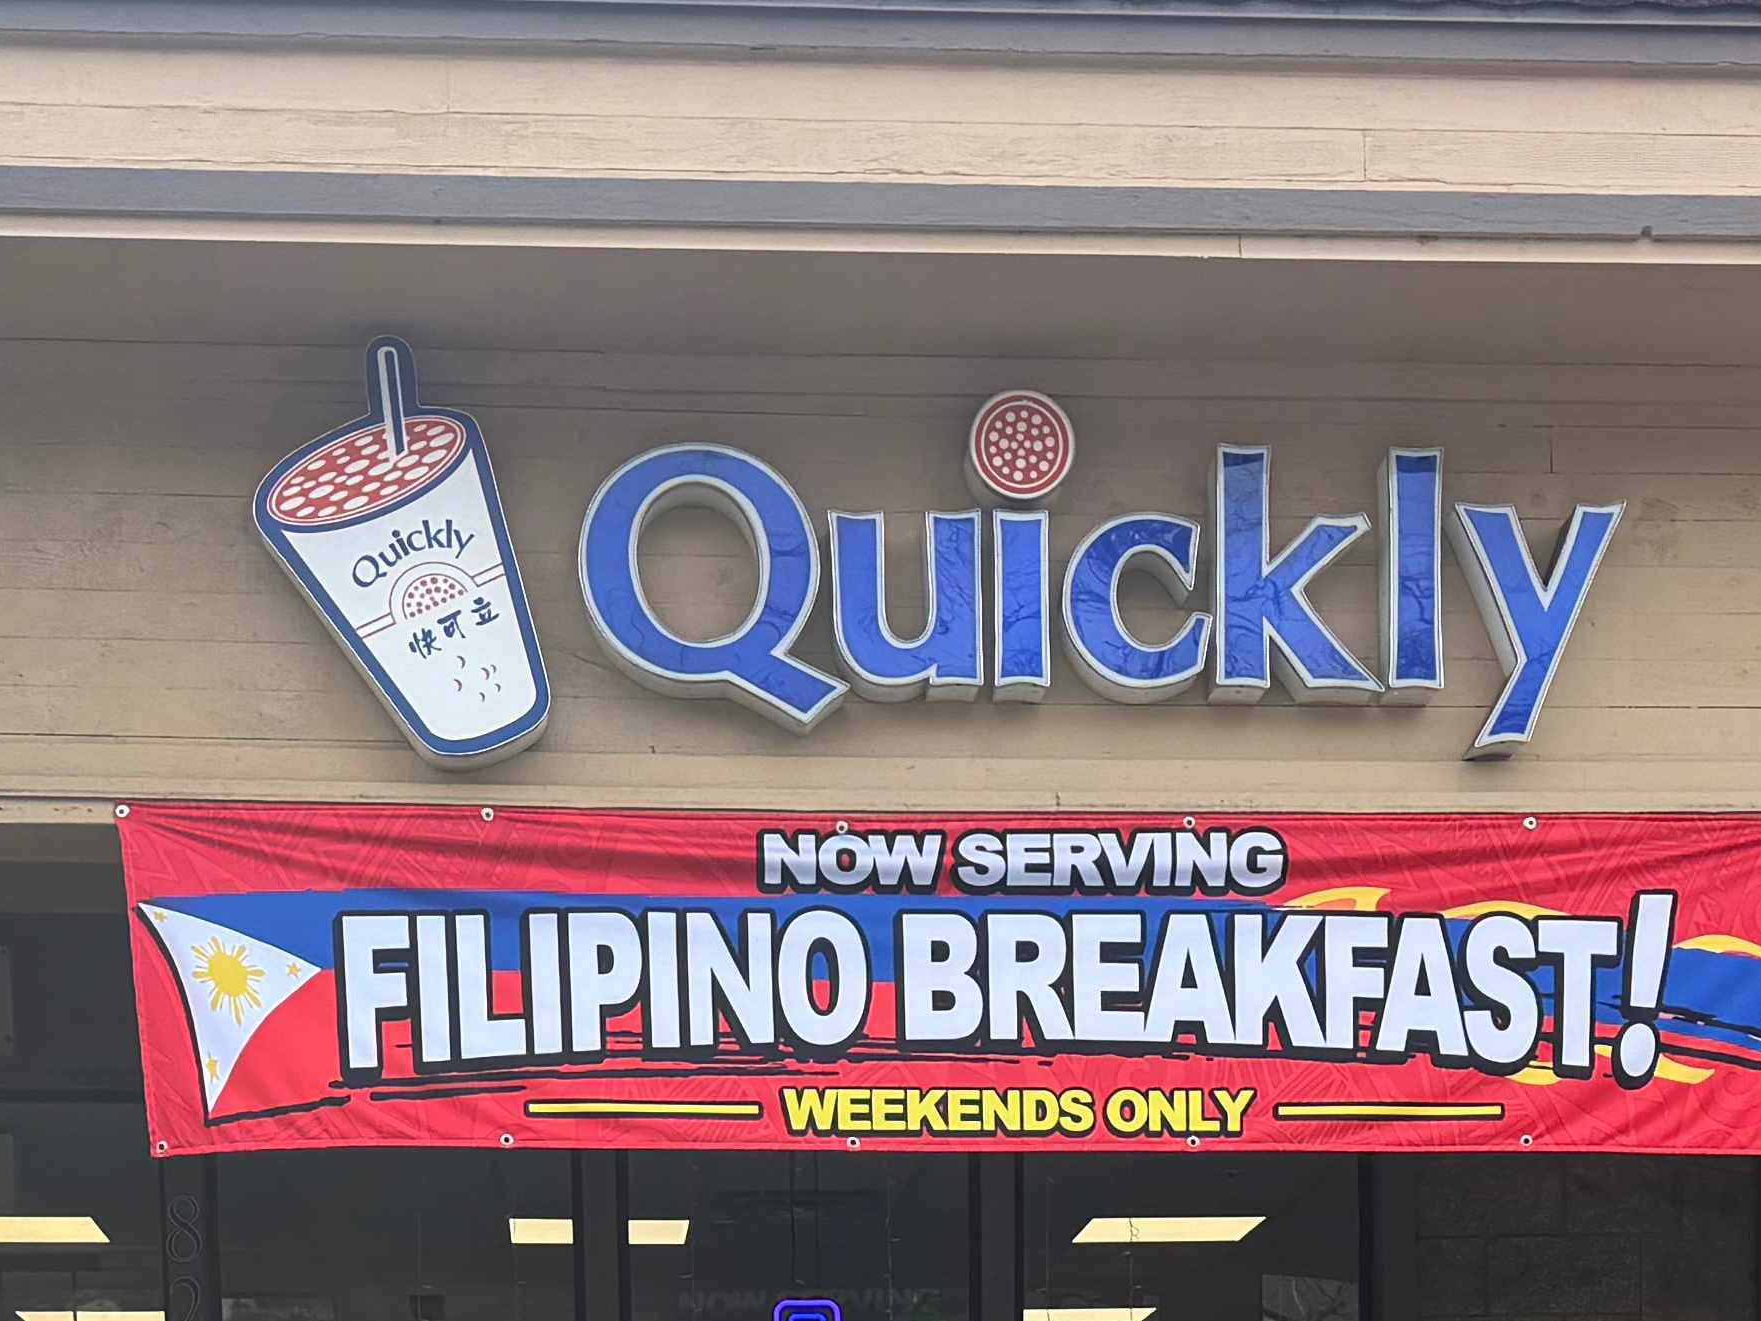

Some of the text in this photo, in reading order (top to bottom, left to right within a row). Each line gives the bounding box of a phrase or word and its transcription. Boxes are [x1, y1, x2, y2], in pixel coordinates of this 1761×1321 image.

[352, 519, 475, 588] Quickly
[578, 389, 1626, 759] Quickly
[408, 596, 500, 659] 快可立
[763, 831, 1285, 888] NOW SERVING
[339, 892, 1675, 1078] FILIPINO BREAKFAST!
[782, 1088, 1256, 1133] WEEKENDS ONLY
